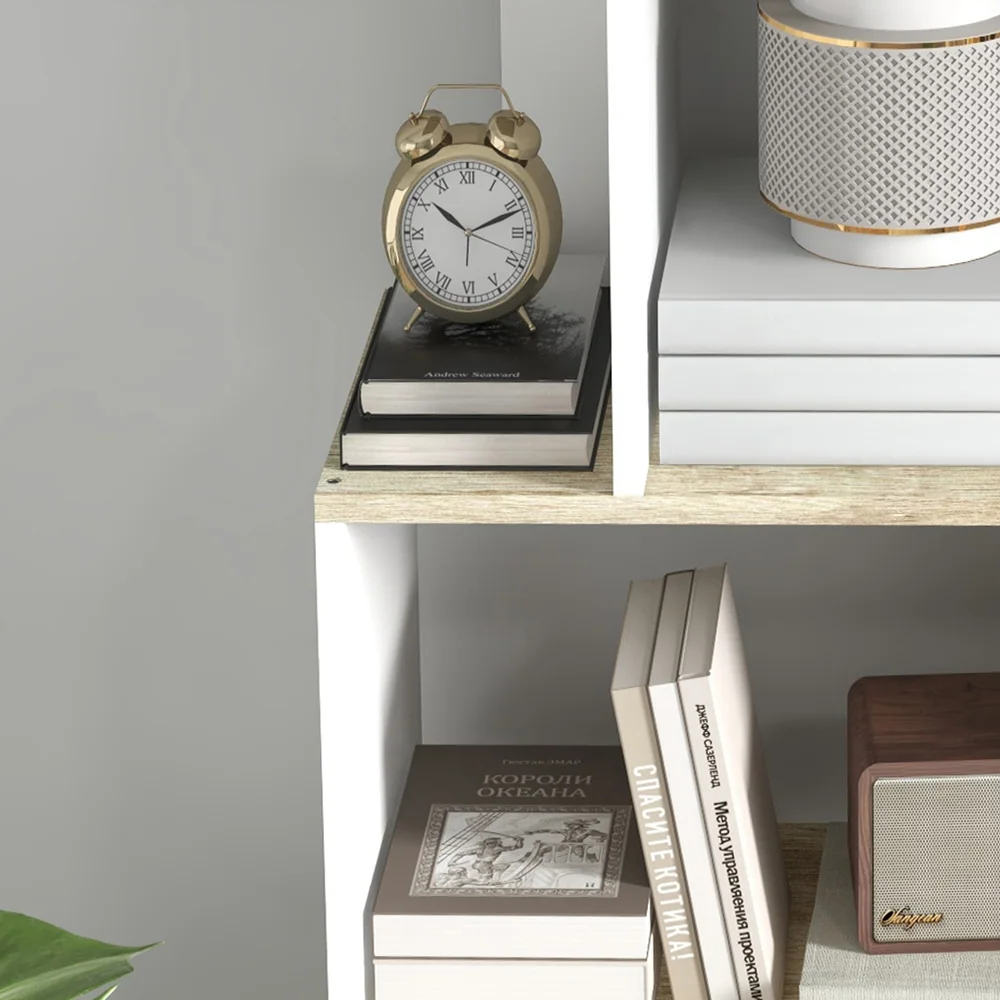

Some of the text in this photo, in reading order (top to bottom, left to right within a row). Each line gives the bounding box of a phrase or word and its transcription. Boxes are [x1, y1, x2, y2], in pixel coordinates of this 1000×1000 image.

[460, 171, 475, 184] XII
[434, 178, 449, 195] XI
[489, 180, 497, 191] I
[417, 198, 431, 212] X
[504, 199, 517, 211] II
[412, 227, 424, 240] IX
[512, 226, 524, 239] III
[417, 248, 435, 272] VIII
[505, 250, 519, 268] IV
[435, 271, 452, 290] VII
[487, 272, 498, 287] V
[462, 281, 475, 294] VI
[695, 704, 721, 788] ДЖЕФФ САЗЕРЛЕНД
[483, 774, 593, 785] КОРОЛИ
[477, 787, 586, 798] ОКЕАНА
[714, 801, 731, 845] Метод
[633, 764, 694, 961] СПАСИТЕ КОТИКА!
[719, 846, 748, 930] управления
